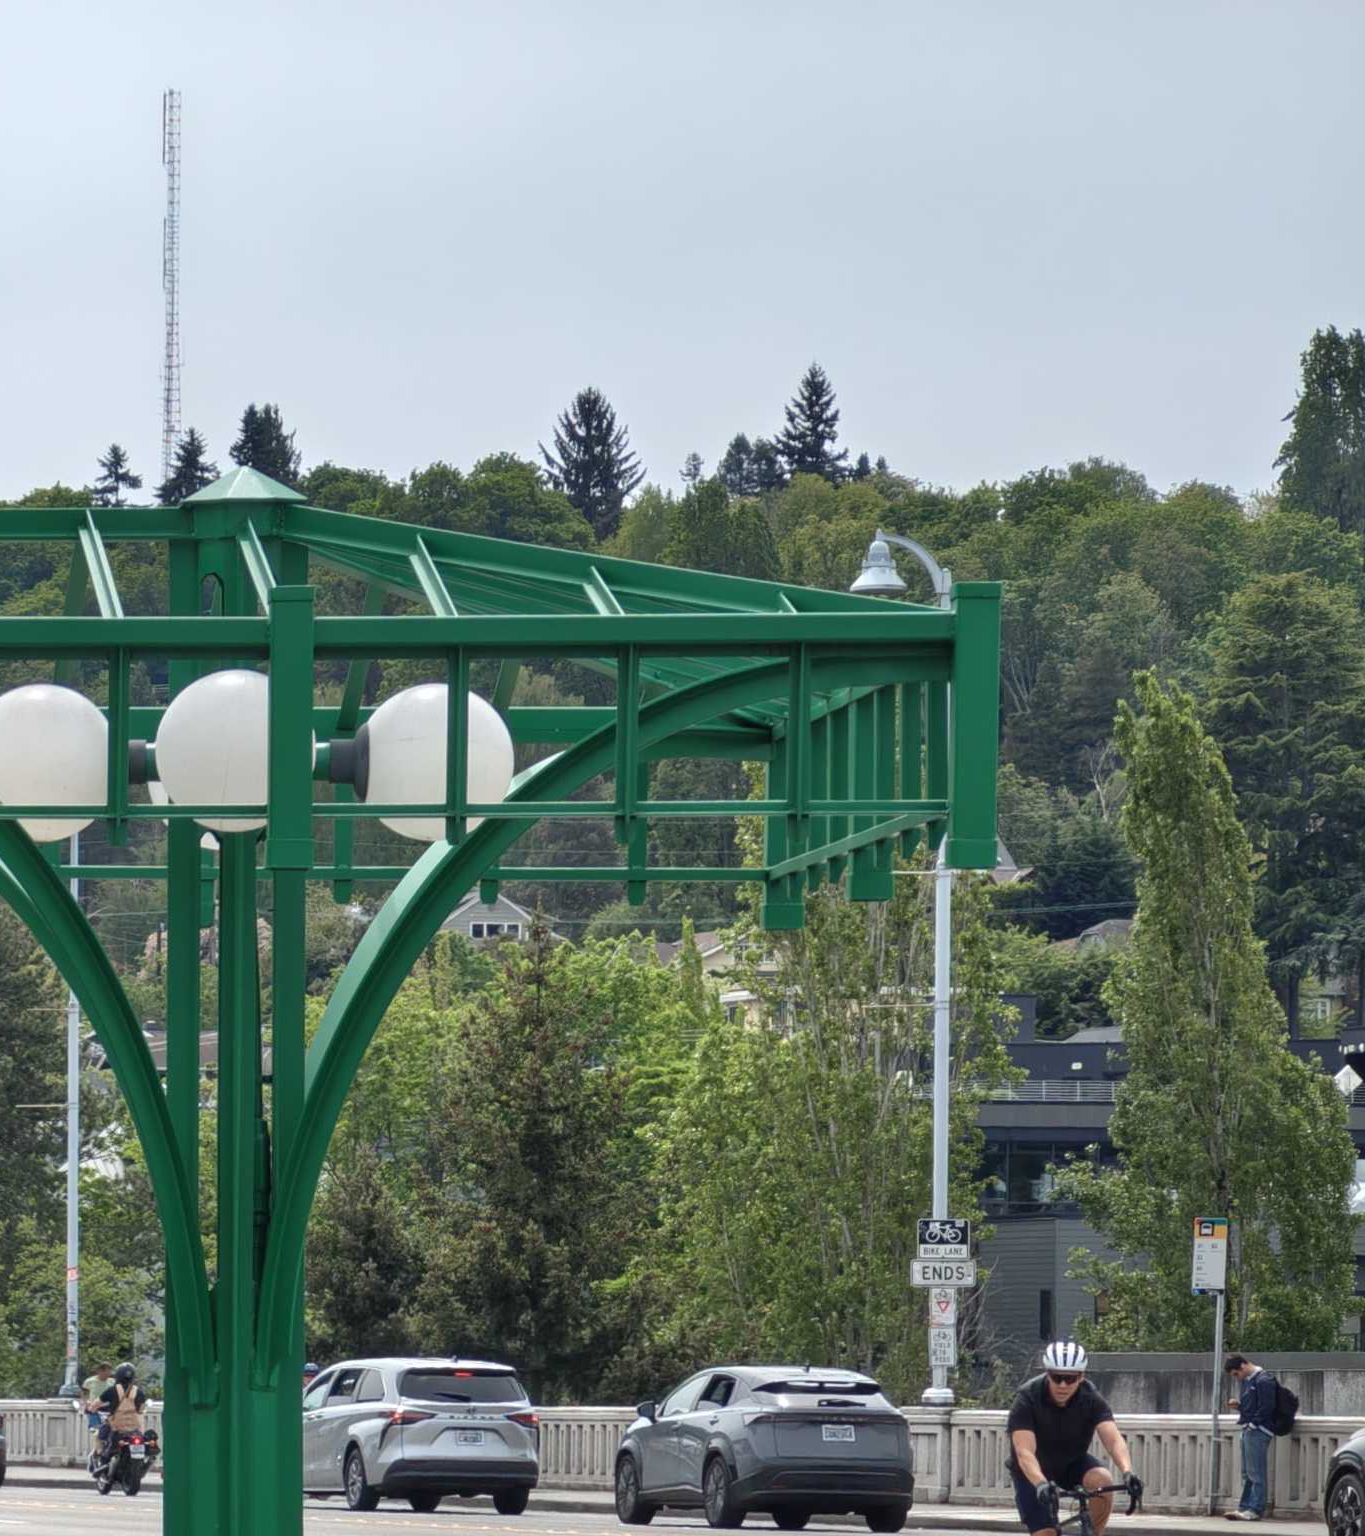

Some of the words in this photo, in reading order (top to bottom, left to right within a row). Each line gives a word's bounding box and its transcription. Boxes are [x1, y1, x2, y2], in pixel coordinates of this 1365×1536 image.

[923, 1247, 940, 1256] BIKE
[944, 1247, 964, 1256] LANE
[922, 1265, 965, 1280] ENDS
